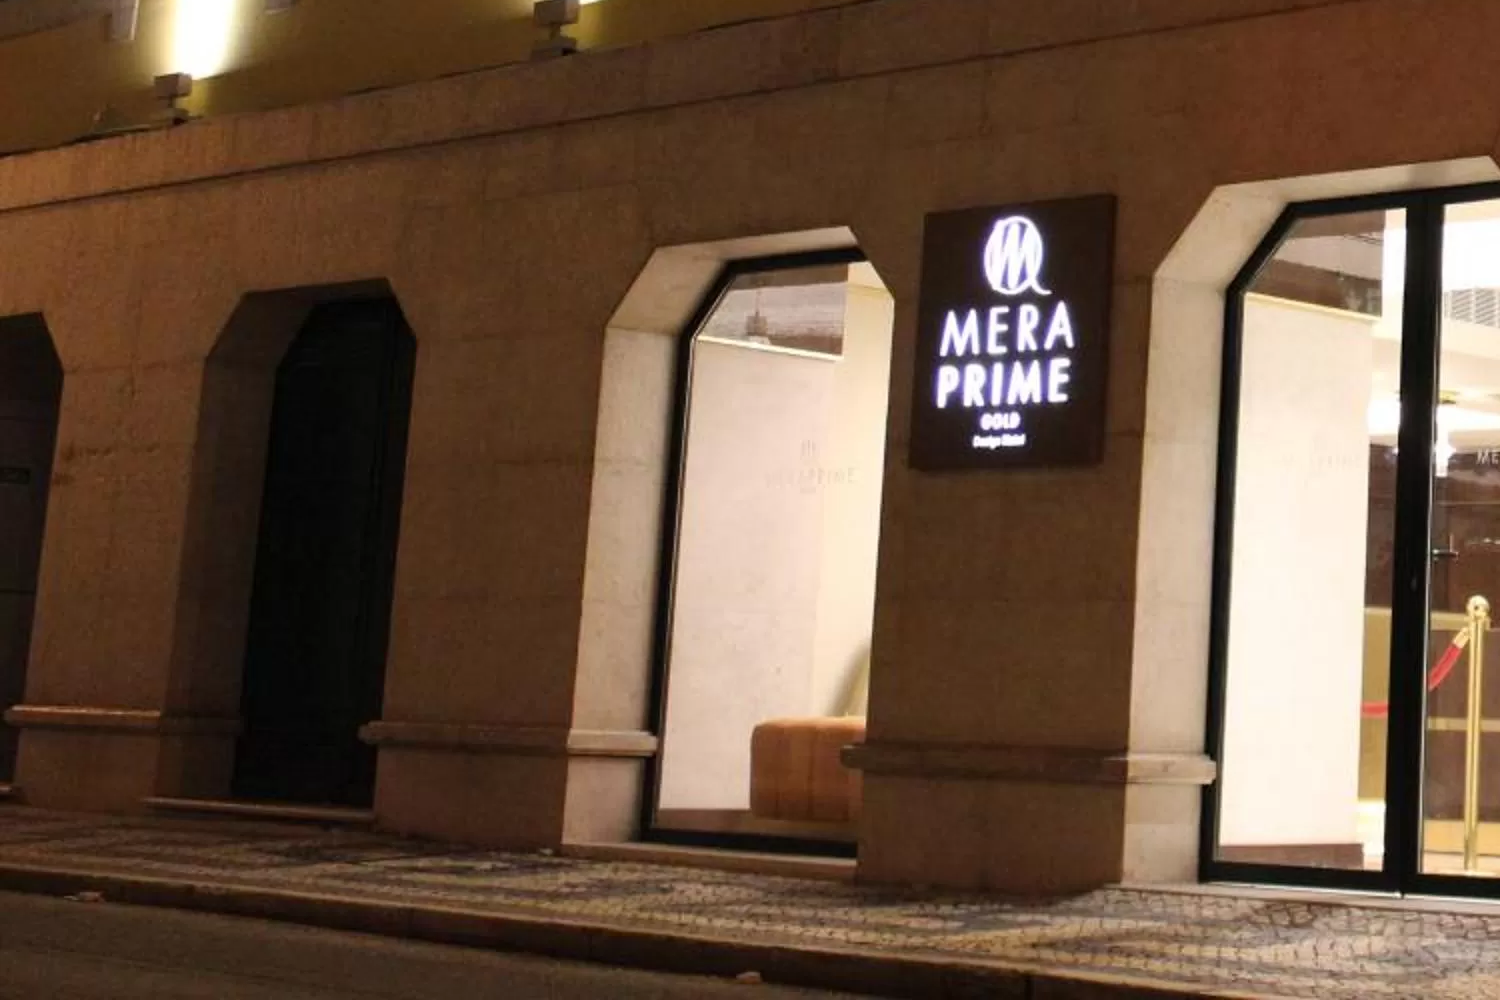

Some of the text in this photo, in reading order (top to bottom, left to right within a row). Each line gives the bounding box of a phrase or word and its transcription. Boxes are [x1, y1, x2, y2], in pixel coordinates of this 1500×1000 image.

[939, 300, 1075, 357] MERA
[936, 357, 1071, 409] PRIME
[980, 411, 1021, 431] GOLD
